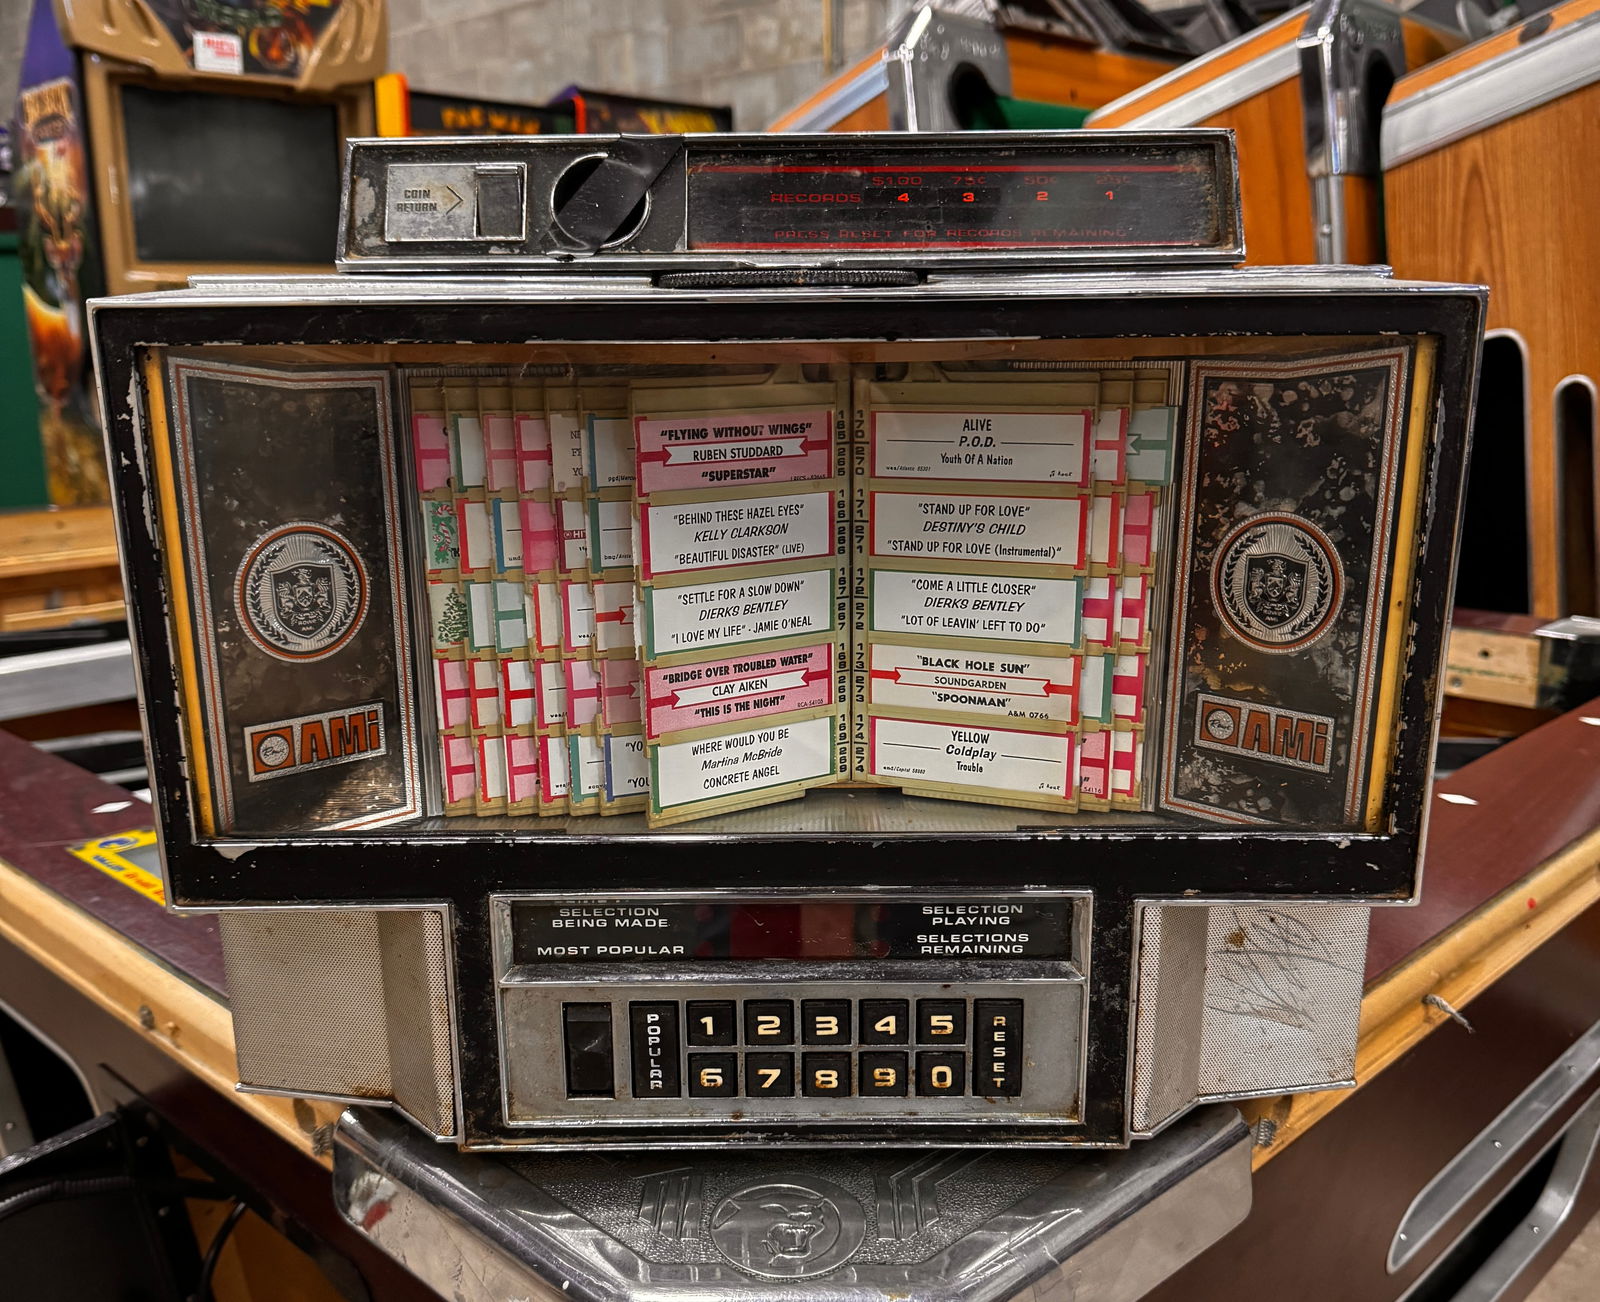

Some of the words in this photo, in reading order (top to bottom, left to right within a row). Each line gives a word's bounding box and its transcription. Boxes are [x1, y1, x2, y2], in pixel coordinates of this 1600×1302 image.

[404, 190, 430, 199] COIN
[770, 193, 861, 203] RECORDS
[898, 192, 910, 202] 4
[962, 192, 974, 202] 3
[1037, 192, 1048, 200] 2
[1104, 190, 1114, 200] 1
[397, 203, 437, 212] RETURN
[774, 230, 829, 239] PRESS
[839, 230, 893, 239] RESET
[903, 229, 937, 238] FOR
[946, 228, 1022, 238] RECORDS
[660, 428, 708, 441] "FLYING
[768, 423, 812, 435] WINGS"
[963, 418, 992, 432] ALIVE
[958, 436, 996, 448] P.O.D.
[693, 448, 727, 461] RUBEN
[730, 446, 783, 459] STUDDARD
[940, 453, 962, 464] Youth
[964, 453, 975, 464] Of
[977, 454, 984, 465] A
[987, 454, 1013, 466] Nation
[702, 467, 776, 482] "SUPERSTAR"
[674, 511, 712, 526] "BEHIND
[715, 508, 743, 522] THESE
[747, 506, 775, 519] HAZEL
[778, 504, 804, 517] EYES"
[918, 503, 955, 515] "STAND
[958, 504, 971, 515] UP
[975, 505, 995, 516] FOR
[999, 505, 1030, 517] LOVE"
[694, 530, 728, 542] KELLY
[731, 523, 788, 539] CLARKSON
[923, 521, 985, 534] DESTINY'S
[989, 524, 1026, 535] CHILD
[675, 549, 728, 564] "BEAUTIFUL
[732, 544, 779, 560] DISASTER"
[782, 543, 804, 555] (LIVE)
[887, 540, 923, 552] "STAND
[927, 542, 940, 552] UP
[942, 542, 963, 553] FOR
[966, 543, 990, 555] LOVE
[994, 544, 1061, 559] (Instrumental)"
[678, 591, 715, 605] "SETTLE
[718, 587, 736, 601] FOR
[739, 587, 745, 598] A
[748, 584, 772, 597] SLOW
[774, 580, 804, 594] DOWN"
[912, 579, 943, 590] "COME
[947, 581, 953, 591] A
[957, 581, 988, 593] LITTLE
[991, 583, 1036, 595] CLOSER"
[699, 606, 739, 621] DIERKS
[743, 600, 788, 615] BENTLEY
[924, 597, 968, 609] DIERKS
[972, 600, 1025, 612] BENTLEY
[672, 633, 679, 644] "I
[682, 629, 705, 643] LOVE
[708, 628, 720, 641] MY
[723, 624, 746, 637] LIFE"
[753, 621, 778, 634] JAMIE
[781, 616, 812, 629] O'NEAL
[901, 615, 923, 626] "LOT
[927, 616, 939, 626] OF
[942, 618, 979, 630] LEAVIN'
[983, 620, 1006, 632] LEFT
[1009, 621, 1022, 632] TO
[1026, 623, 1046, 634] DO"
[663, 669, 702, 684] "BRIDGE
[706, 666, 729, 678] OVER
[733, 659, 776, 674] TROUBLED
[780, 653, 813, 667] WATER"
[917, 654, 959, 669] "BLACK
[966, 660, 994, 671] HOLE
[1000, 663, 1030, 674] SUN"
[712, 684, 735, 697] CLAY
[739, 678, 768, 692] AIKEN
[934, 676, 1006, 690] SOUNDGARDEN
[694, 706, 720, 718] "THIS
[723, 704, 731, 715] IS
[735, 701, 750, 713] THE
[753, 695, 785, 710] NIGHT"
[932, 692, 1011, 708] "SPOONMAN"
[692, 742, 722, 756] WHERE
[725, 736, 754, 750] WOULD
[758, 732, 775, 744] YOU
[778, 728, 789, 740] BE
[951, 731, 989, 744] YELLOW
[701, 756, 739, 771] Martina
[742, 747, 782, 763] McBride
[946, 744, 996, 761] Coldplay
[957, 761, 983, 773] Trouble
[703, 772, 749, 790] CONCRETE
[752, 766, 780, 779] ANGEL
[560, 908, 659, 917] SELECTION
[922, 905, 1023, 915] SELECTION
[552, 919, 607, 928] BEING
[615, 919, 669, 928] MADE
[932, 917, 1010, 926] PLAYING
[916, 934, 1029, 943] SELECTIONS
[537, 946, 590, 955] MOST
[597, 946, 684, 955] POPULAR
[921, 945, 1023, 954] REMAINING
[700, 1016, 713, 1036] 1
[757, 1016, 781, 1036] 2
[815, 1016, 838, 1036] 3
[874, 1015, 897, 1035] 4
[930, 1015, 954, 1035] 5
[646, 1014, 663, 1090] POPULAR
[993, 1016, 1006, 1088] RESET
[700, 1068, 723, 1088] 6
[757, 1068, 781, 1088] 7
[815, 1069, 838, 1088] 8
[873, 1068, 896, 1087] 9
[931, 1066, 953, 1088] 0
